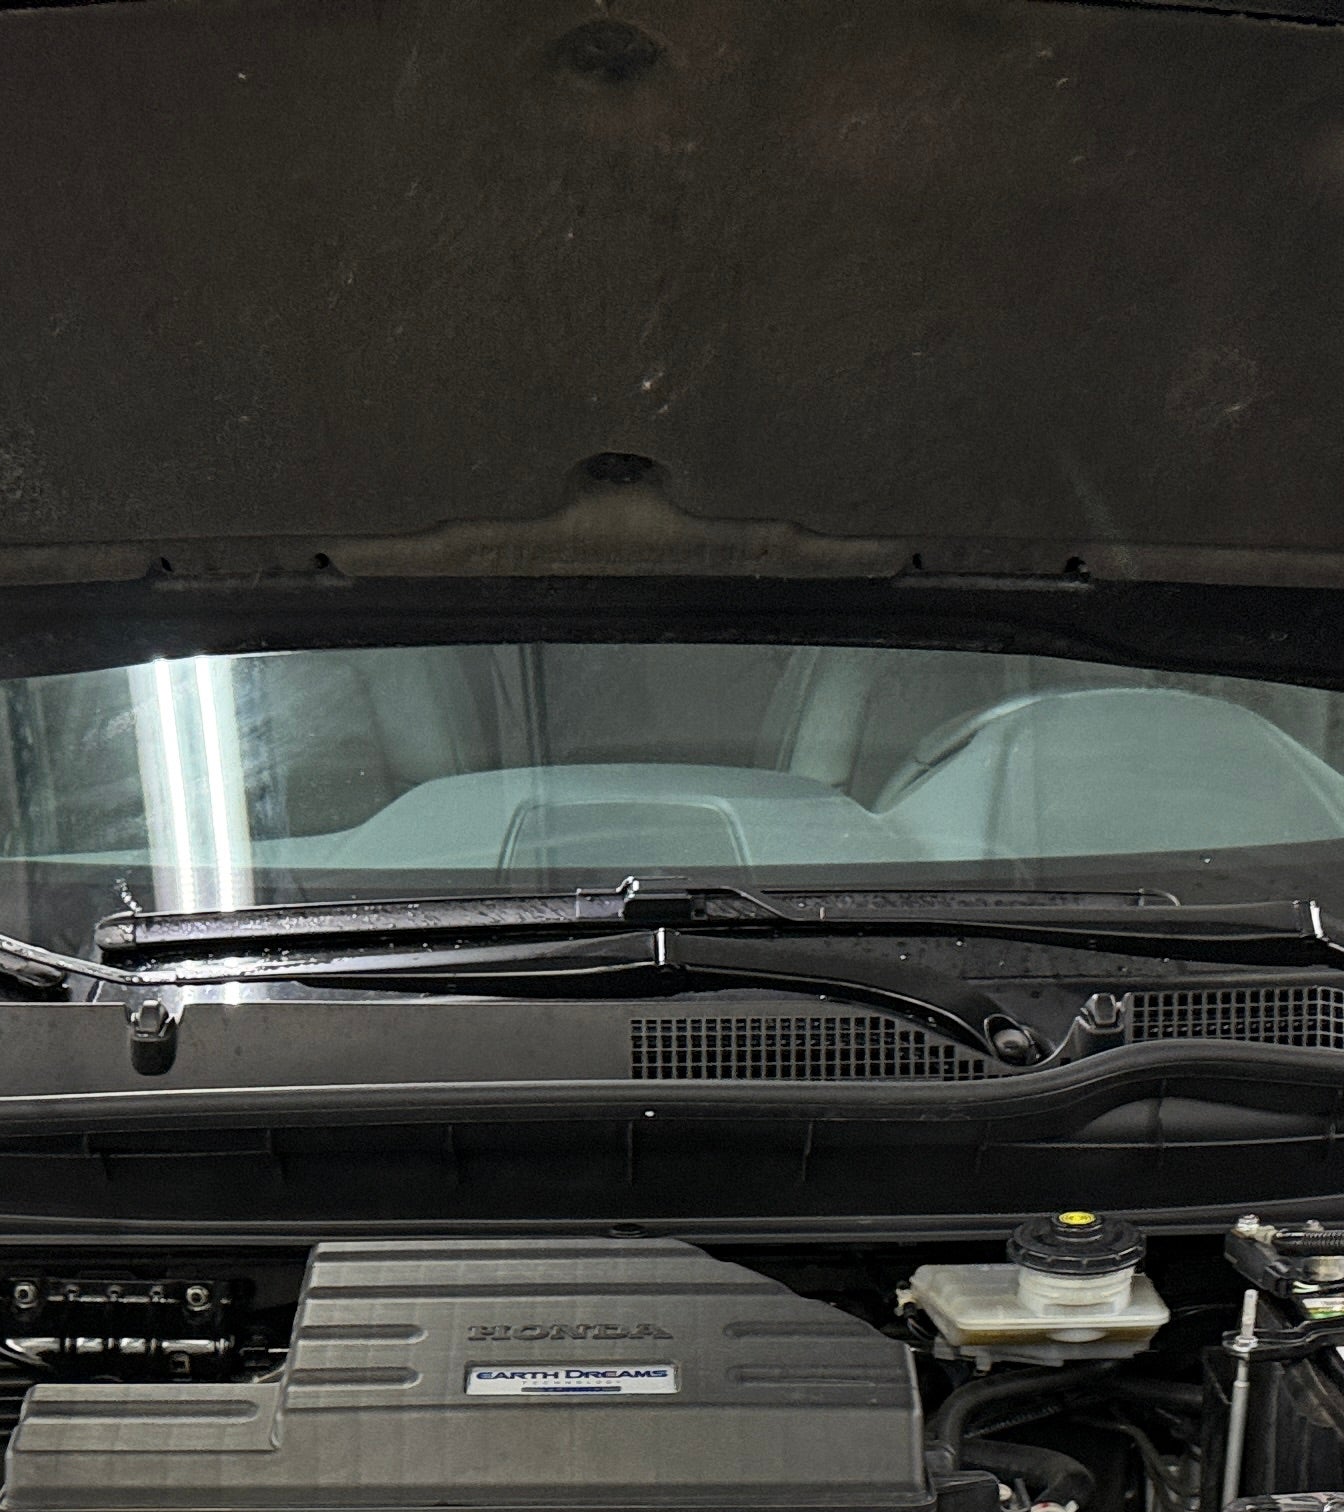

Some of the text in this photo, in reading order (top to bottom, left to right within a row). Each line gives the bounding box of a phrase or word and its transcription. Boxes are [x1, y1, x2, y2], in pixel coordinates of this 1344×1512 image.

[467, 1323, 674, 1341] HONDA
[476, 1369, 669, 1380] EARTH DREAMS
